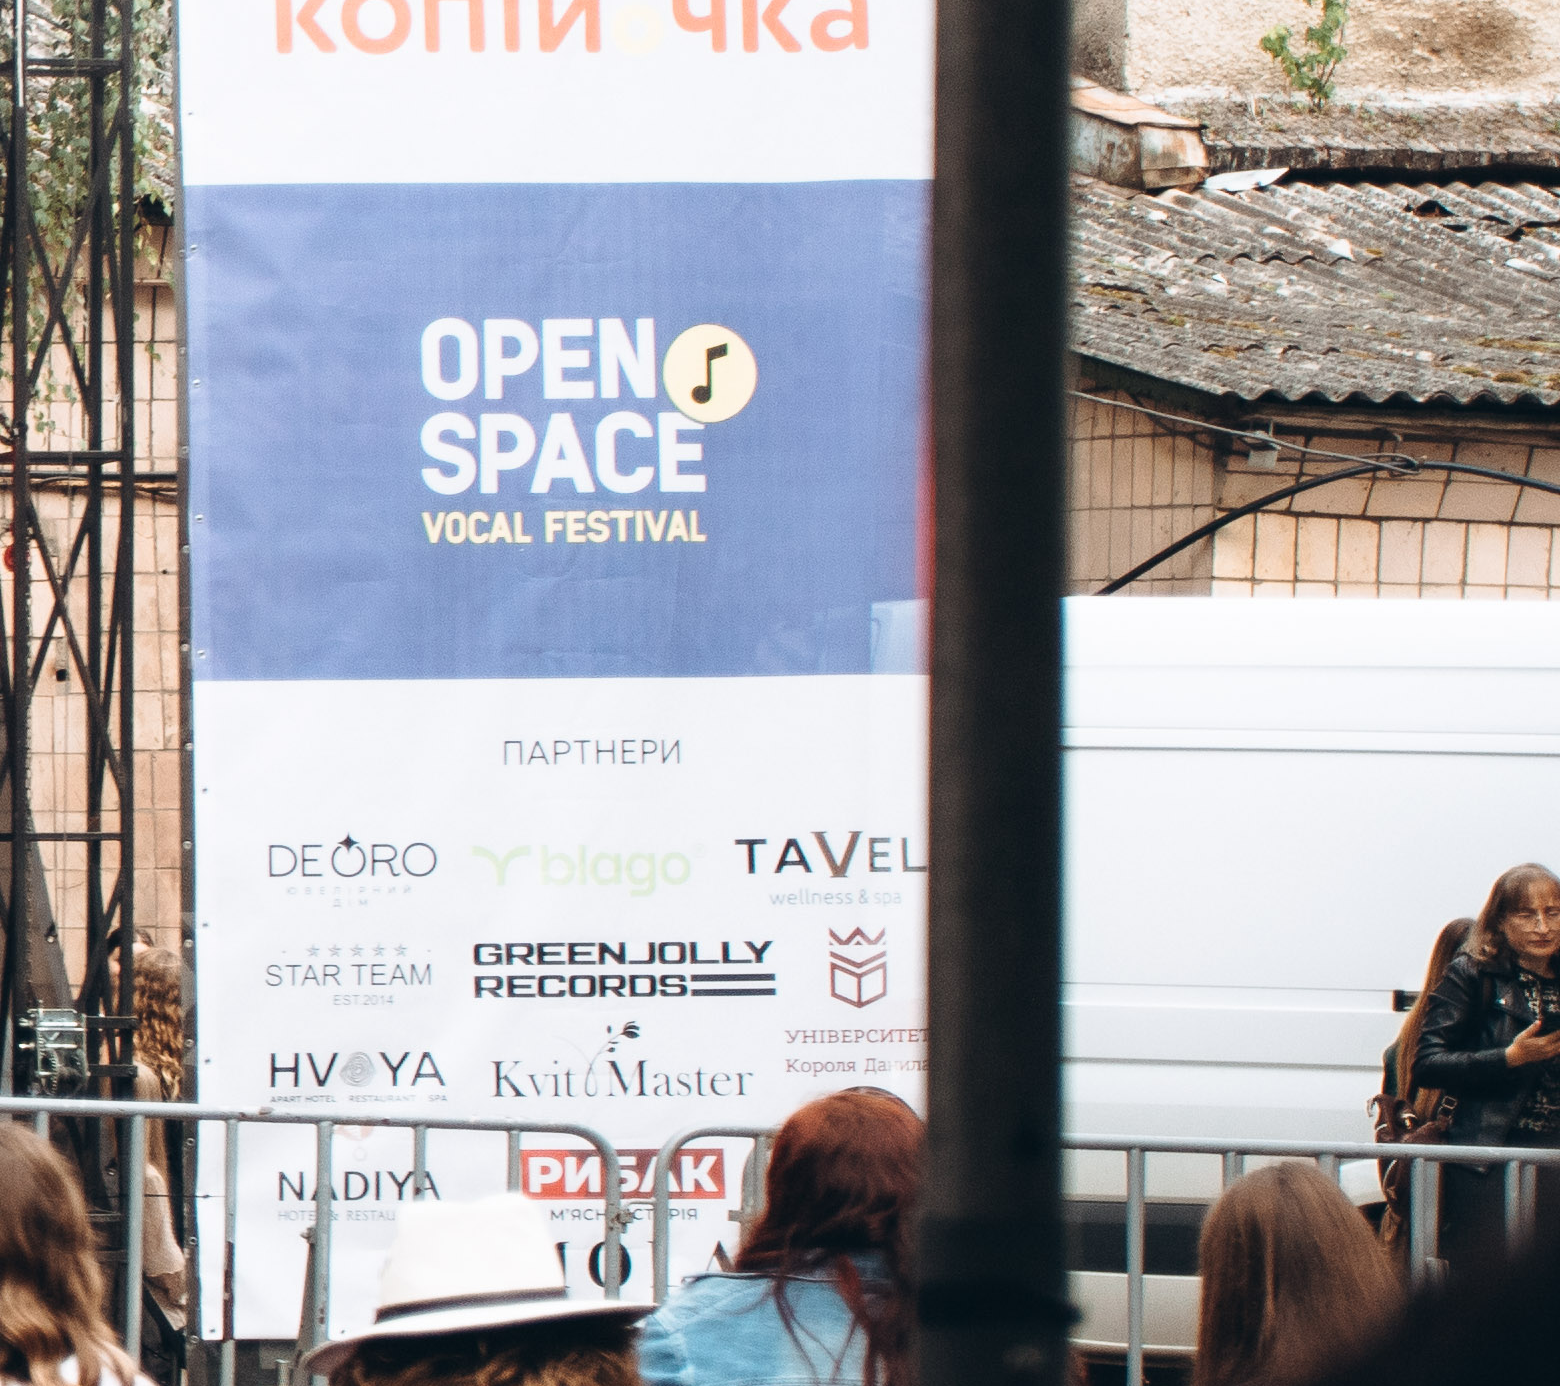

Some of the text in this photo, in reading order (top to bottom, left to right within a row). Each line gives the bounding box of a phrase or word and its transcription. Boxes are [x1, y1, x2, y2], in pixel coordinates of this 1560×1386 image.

[420, 317, 656, 401] OPEN
[420, 412, 707, 496] SPACE
[421, 509, 707, 545] VOCAL FESTIVAL
[502, 738, 683, 767] ПАРТНЕРИ
[770, 888, 902, 906] wellness & spa
[265, 963, 432, 987] STAR TEAM
[472, 974, 689, 999] RECORDS
[785, 1058, 856, 1077] Короля
